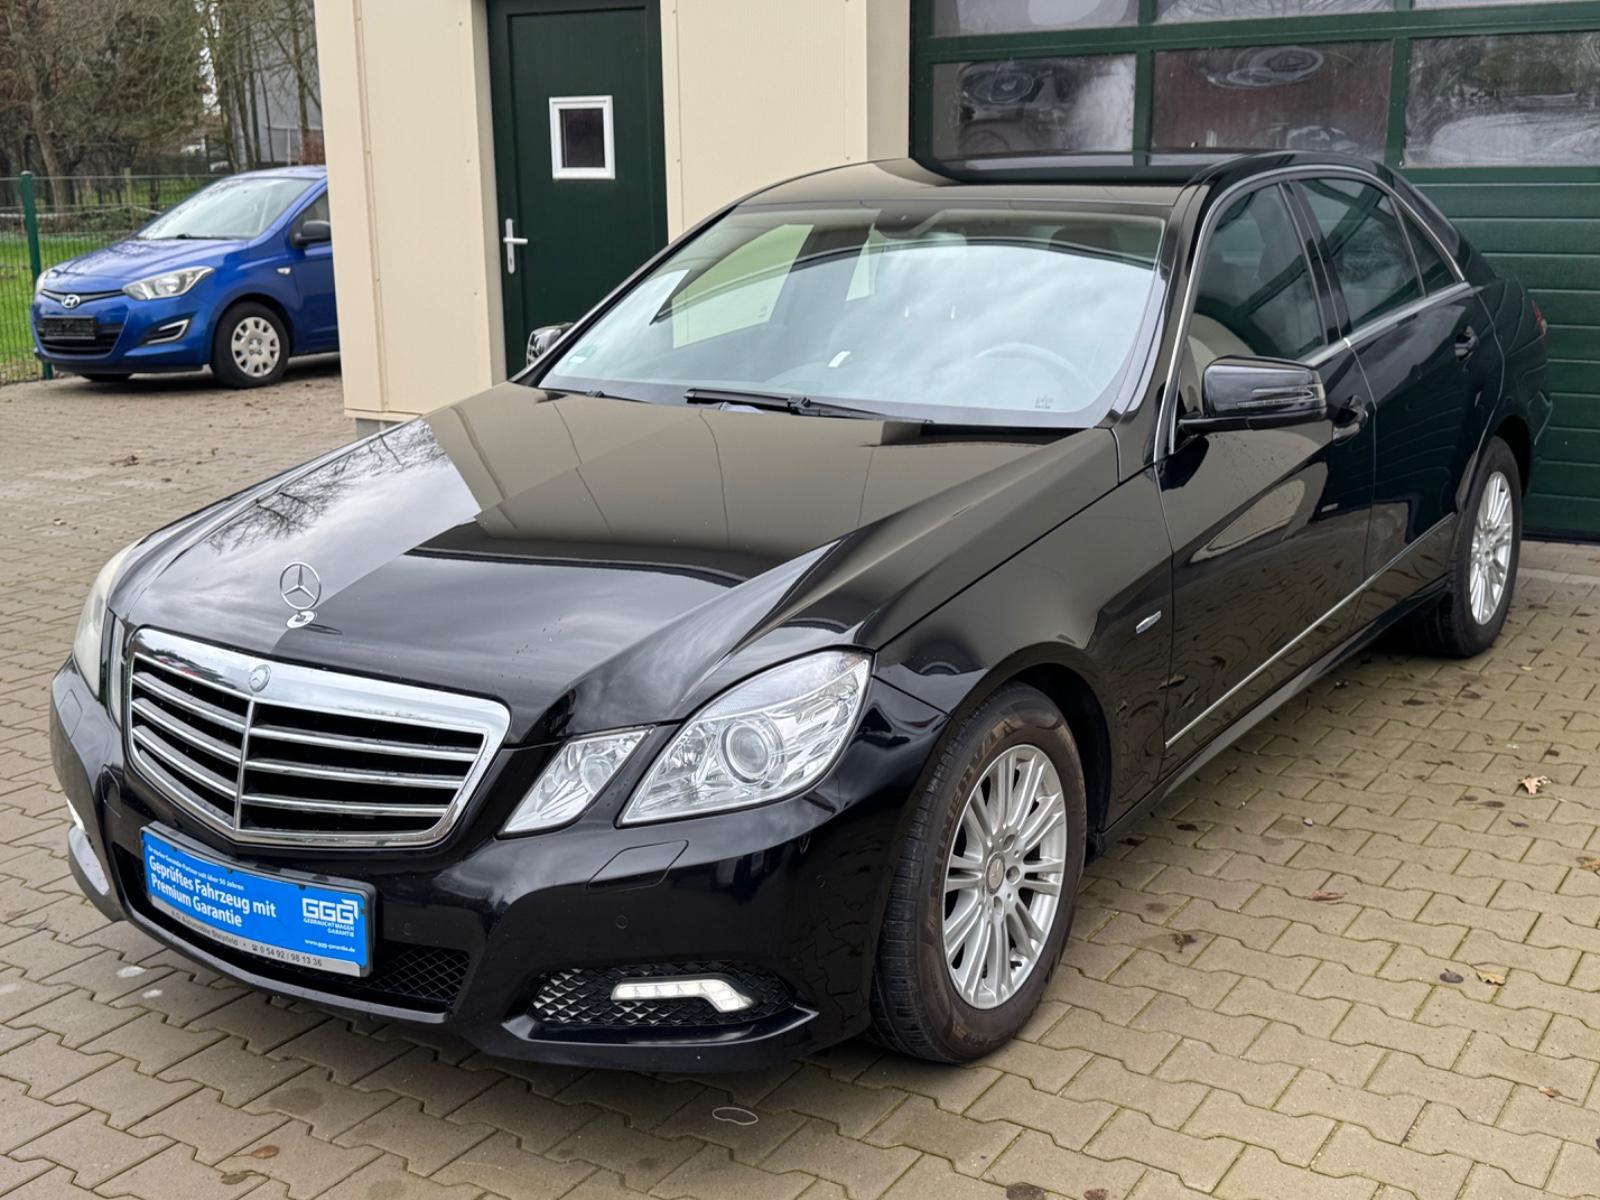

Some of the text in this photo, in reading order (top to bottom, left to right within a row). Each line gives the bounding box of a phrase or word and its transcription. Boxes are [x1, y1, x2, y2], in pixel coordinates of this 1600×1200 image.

[148, 855, 277, 918] Geprüftes Fahrzeug mit
[150, 873, 243, 927] Premium Garantie
[302, 897, 356, 925] GGG
[303, 917, 355, 931] GEBRAUCHTWAGEN
[327, 927, 355, 938] GARANTIE
